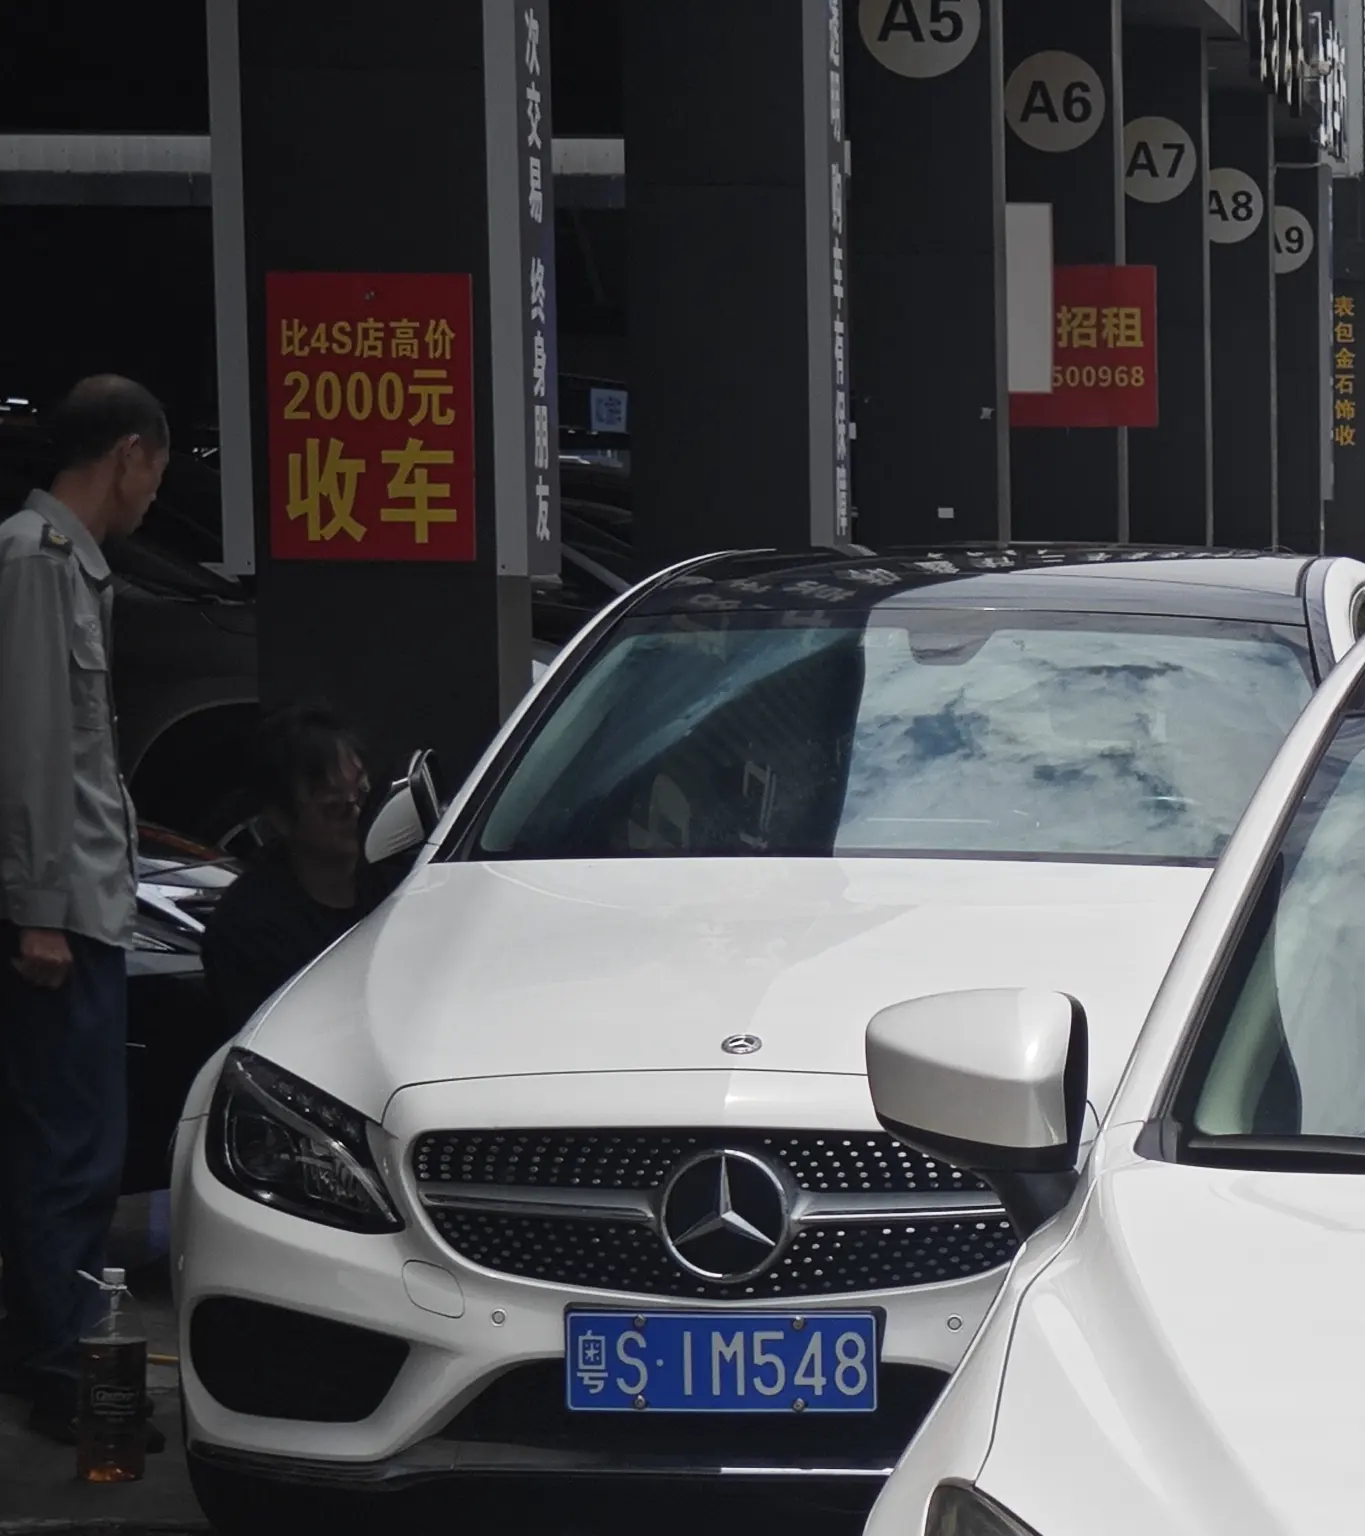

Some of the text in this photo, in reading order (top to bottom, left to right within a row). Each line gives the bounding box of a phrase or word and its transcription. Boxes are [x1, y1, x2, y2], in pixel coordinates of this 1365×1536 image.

[877, 0, 963, 43] A5
[1020, 80, 1092, 123] A6
[1125, 141, 1185, 178] A7
[280, 318, 455, 360] 比4S店高价
[1056, 305, 1144, 348] 招租
[283, 369, 455, 427] 2000元
[1052, 366, 1145, 387] 500968
[286, 437, 457, 543] 收车
